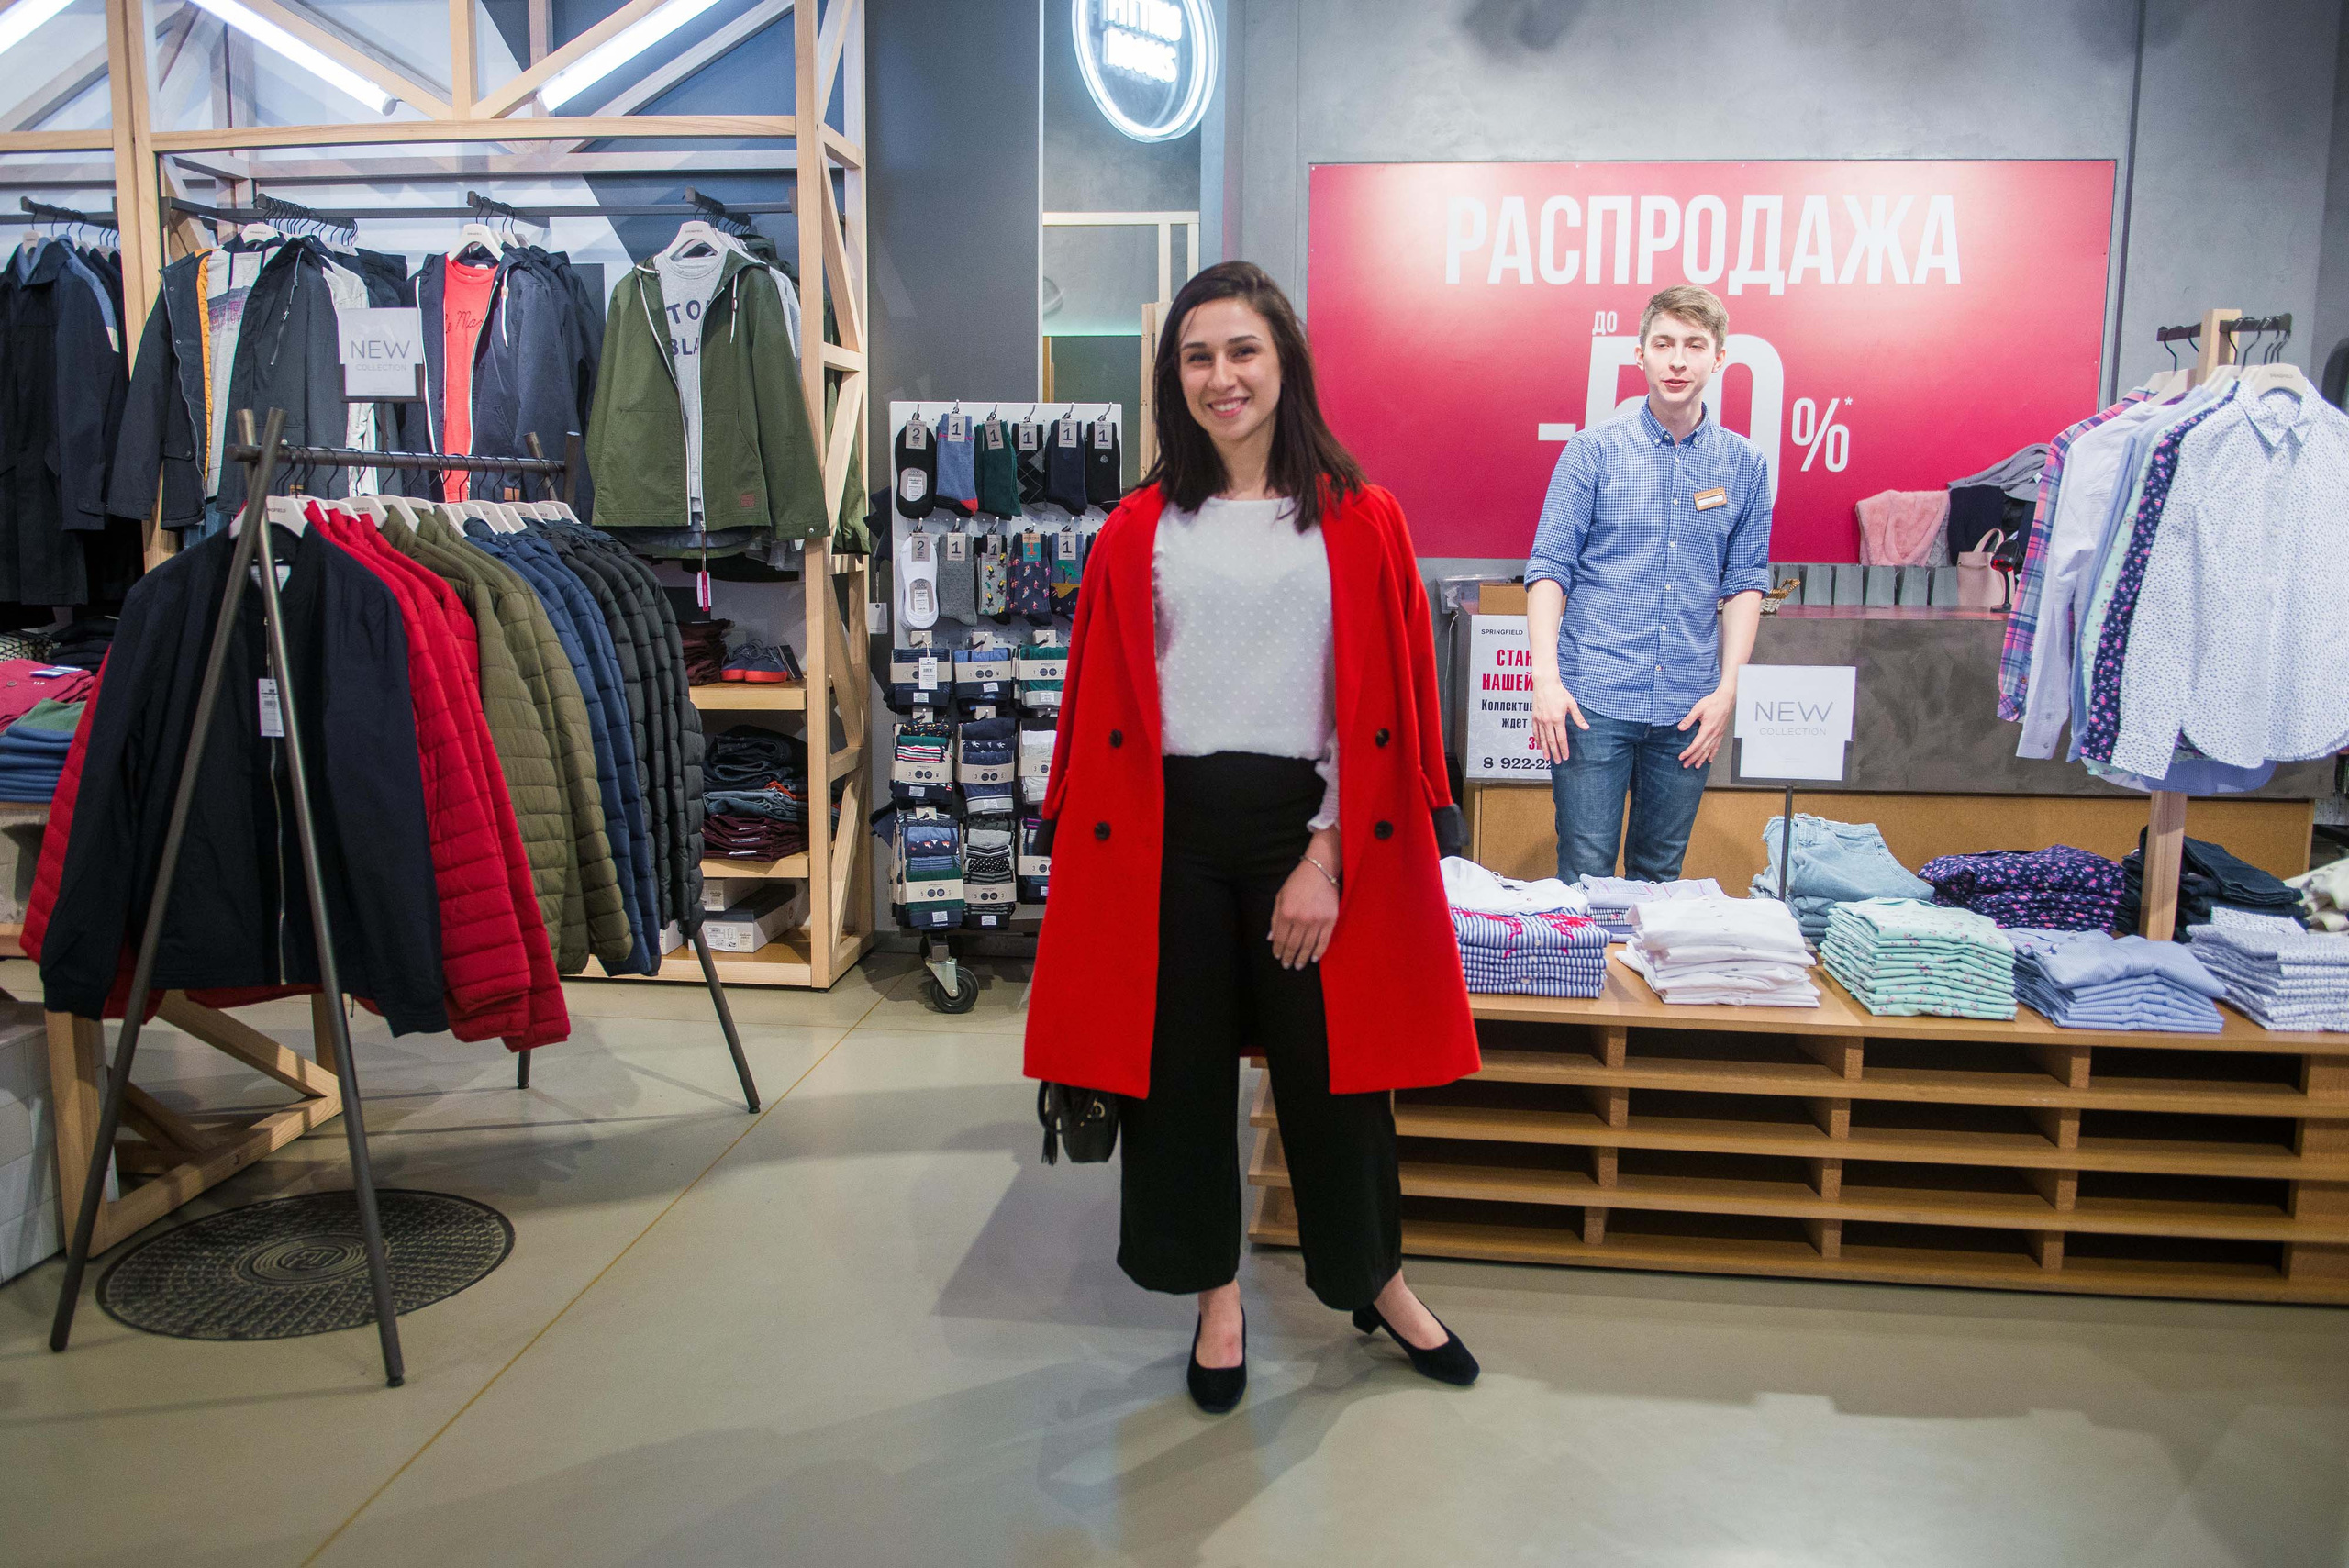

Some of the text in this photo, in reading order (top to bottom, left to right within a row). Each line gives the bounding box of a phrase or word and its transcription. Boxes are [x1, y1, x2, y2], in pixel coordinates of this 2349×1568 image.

[1444, 194, 1962, 296] РАСПРОДАЖА
[666, 299, 711, 324] TO
[1592, 310, 1618, 336] ДО
[351, 339, 411, 359] NEW
[356, 363, 406, 372] COLLECTION
[912, 428, 921, 439] 2
[952, 422, 961, 436] 1
[990, 429, 999, 442] 1
[1063, 428, 1073, 441] 1
[1098, 429, 1108, 442] 1
[1023, 431, 1033, 444] 1
[917, 540, 925, 551] 2
[952, 541, 962, 554] 1
[990, 543, 998, 556] 1
[1026, 542, 1037, 555] 1
[1063, 541, 1072, 554] 1
[1482, 672, 1534, 692] НАШЕЙ
[1754, 701, 1833, 722] NEW
[1501, 717, 1528, 729] ждет
[1759, 728, 1827, 736] COLLECTION
[1483, 756, 1494, 769] 8
